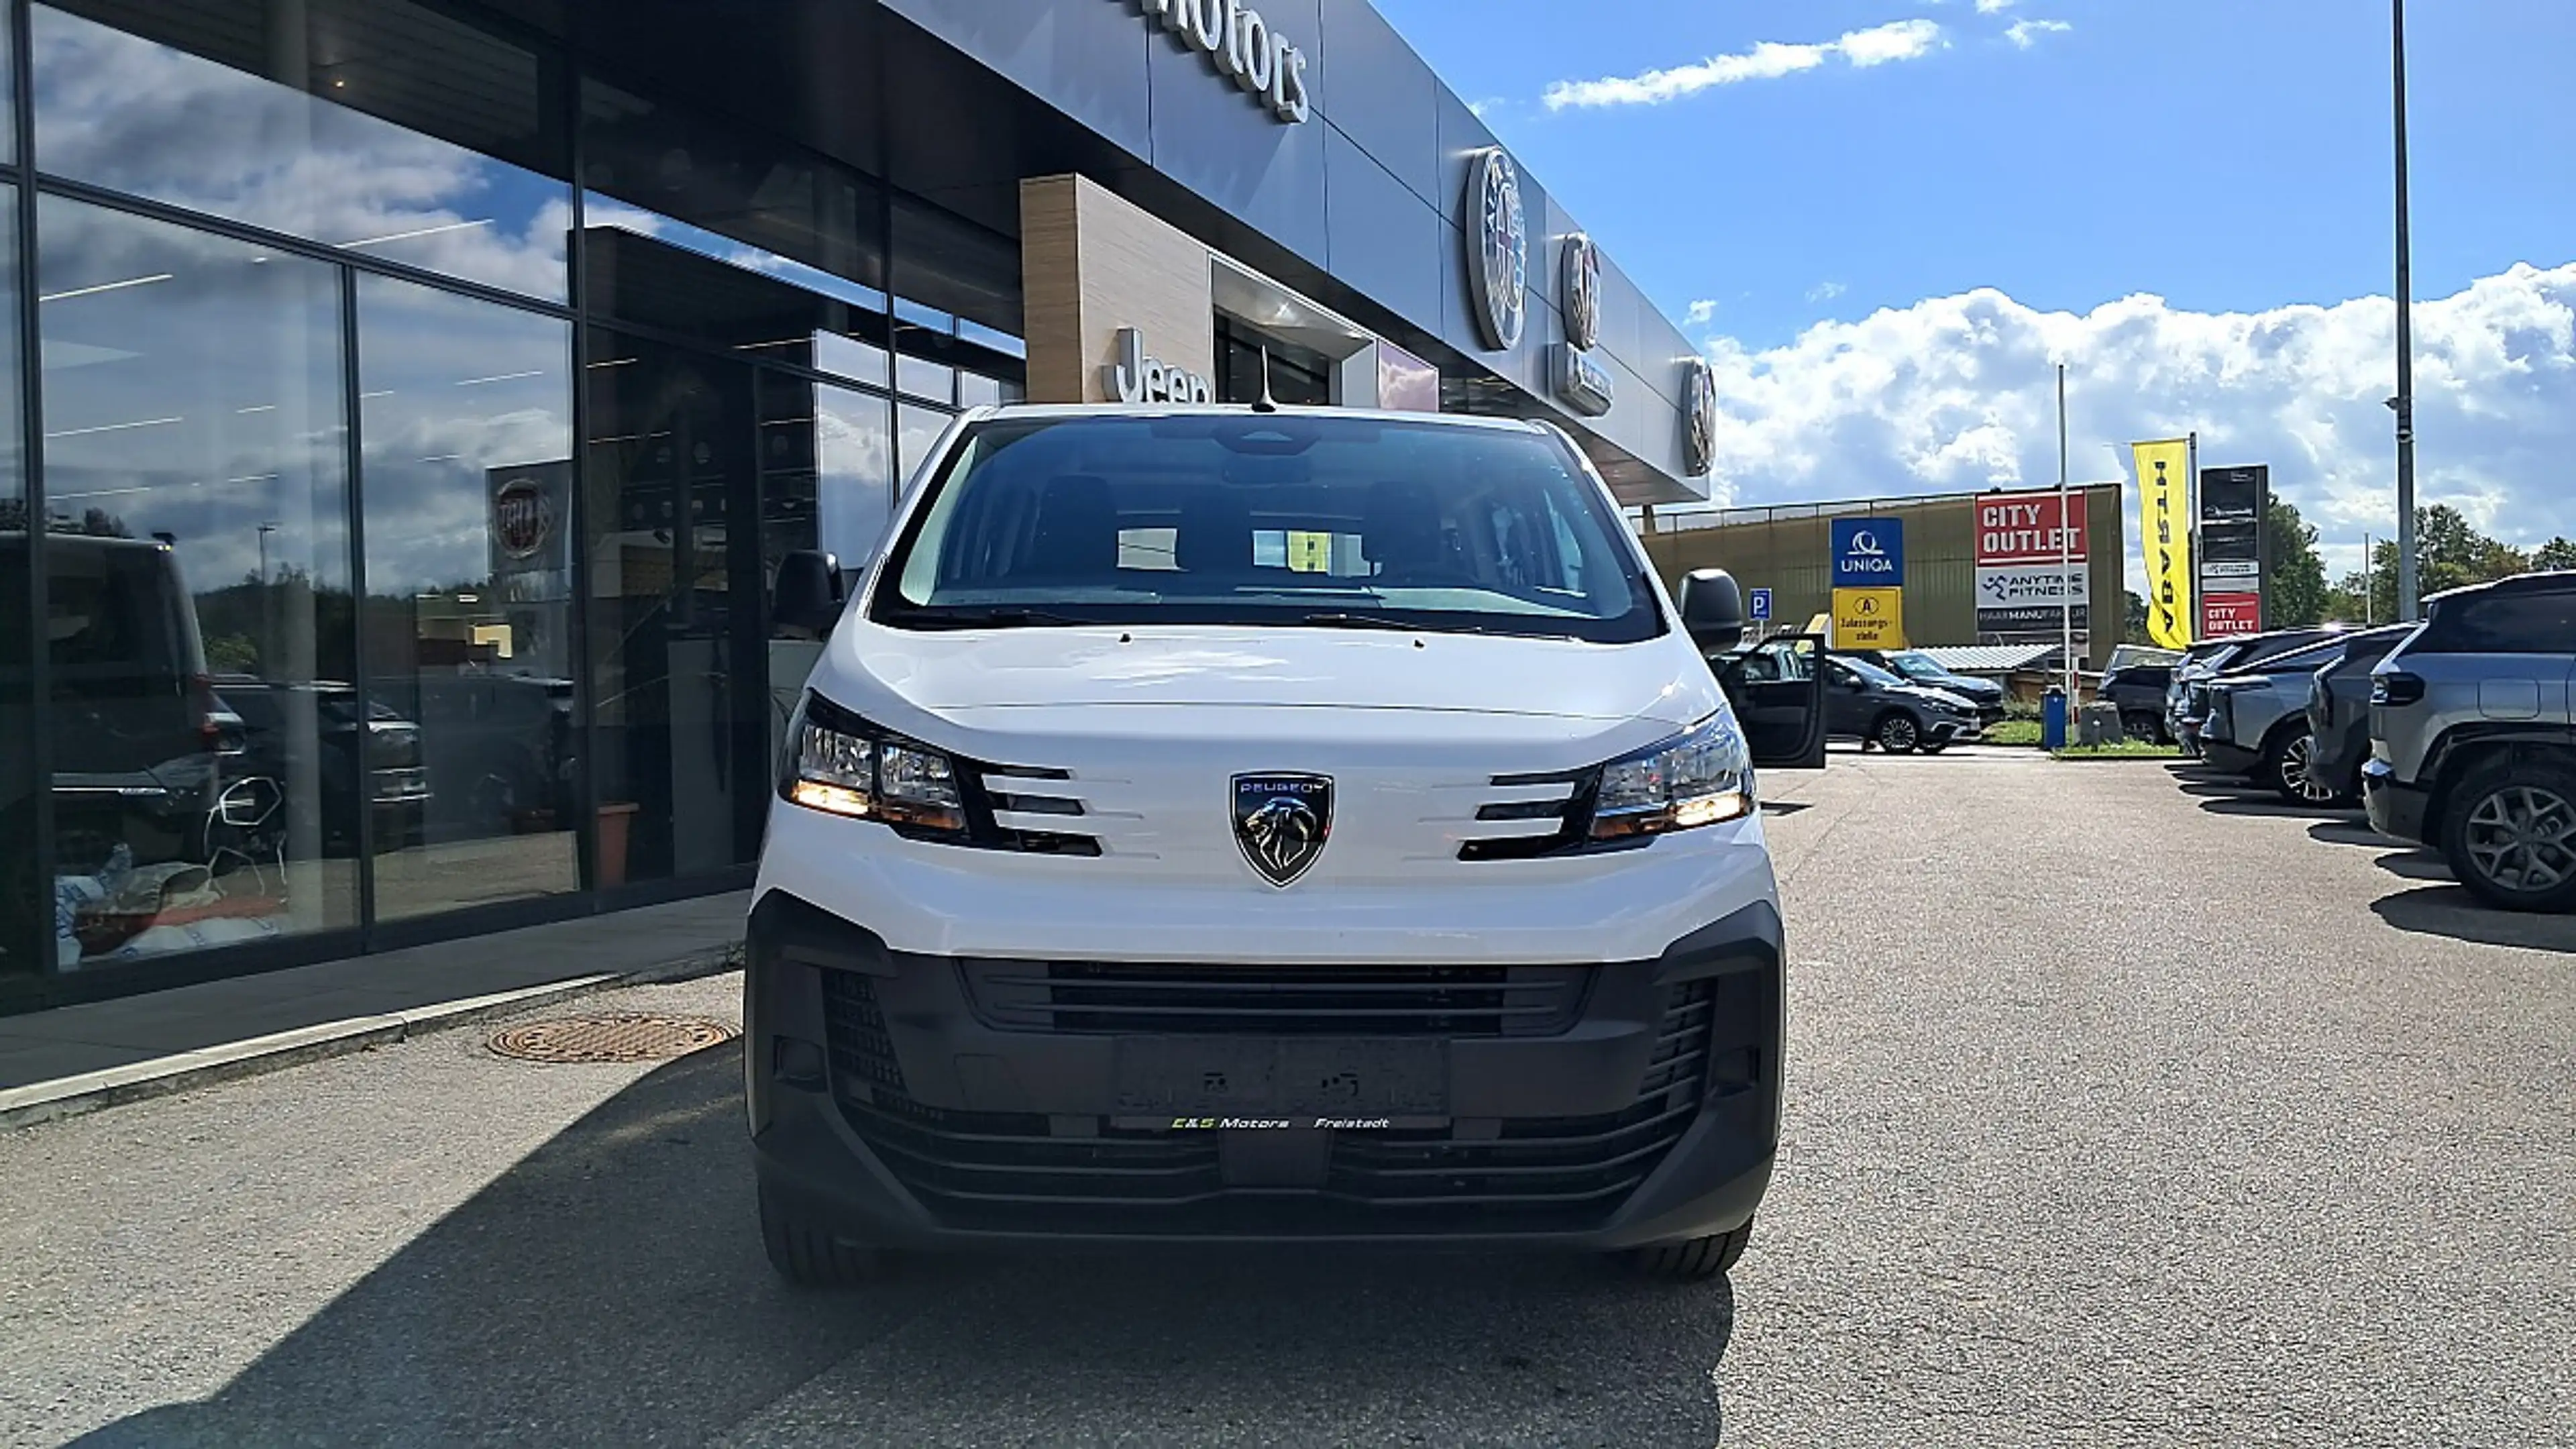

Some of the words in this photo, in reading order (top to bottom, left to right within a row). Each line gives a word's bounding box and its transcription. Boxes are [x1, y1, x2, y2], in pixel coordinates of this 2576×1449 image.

[1142, 0, 1309, 125] otors
[1983, 504, 2041, 527] CITY
[1983, 528, 2081, 553] OUTLET
[2208, 608, 2236, 619] CITY
[2208, 620, 2253, 630] OUTLET
[1220, 1118, 1289, 1128] Motors
[1313, 1118, 1390, 1128] Freistadt
